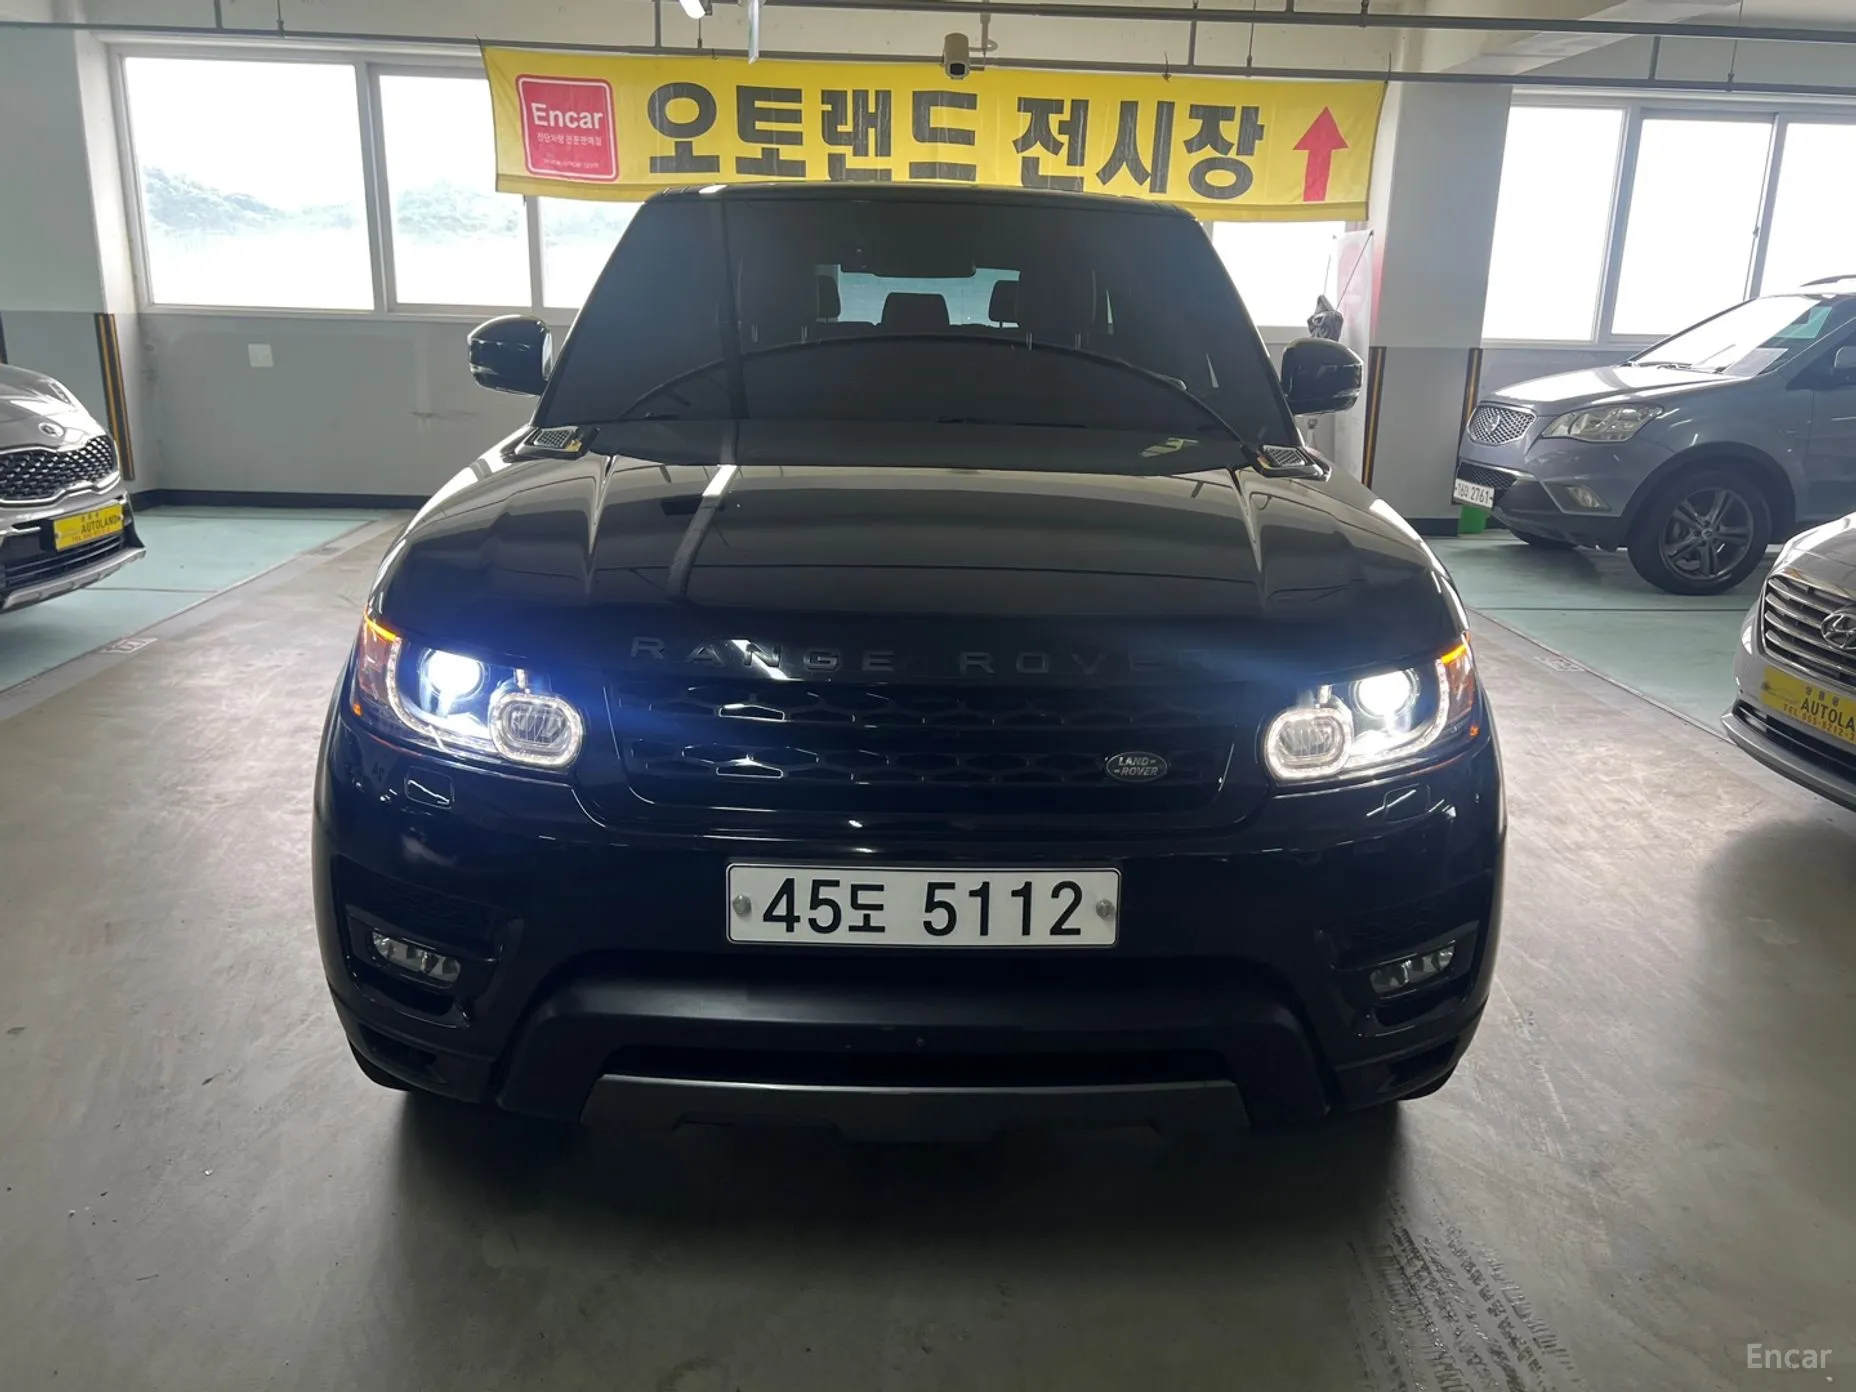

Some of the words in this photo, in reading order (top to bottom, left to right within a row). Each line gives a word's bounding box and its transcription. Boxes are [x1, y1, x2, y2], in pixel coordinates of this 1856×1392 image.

[531, 102, 603, 129] Encar
[647, 82, 978, 182] 오토랜드
[1012, 96, 1265, 200] 전시장
[1470, 486, 1489, 504] 2761
[630, 636, 896, 672] RANGE
[762, 878, 886, 934] 45도
[923, 880, 1083, 936] 5112
